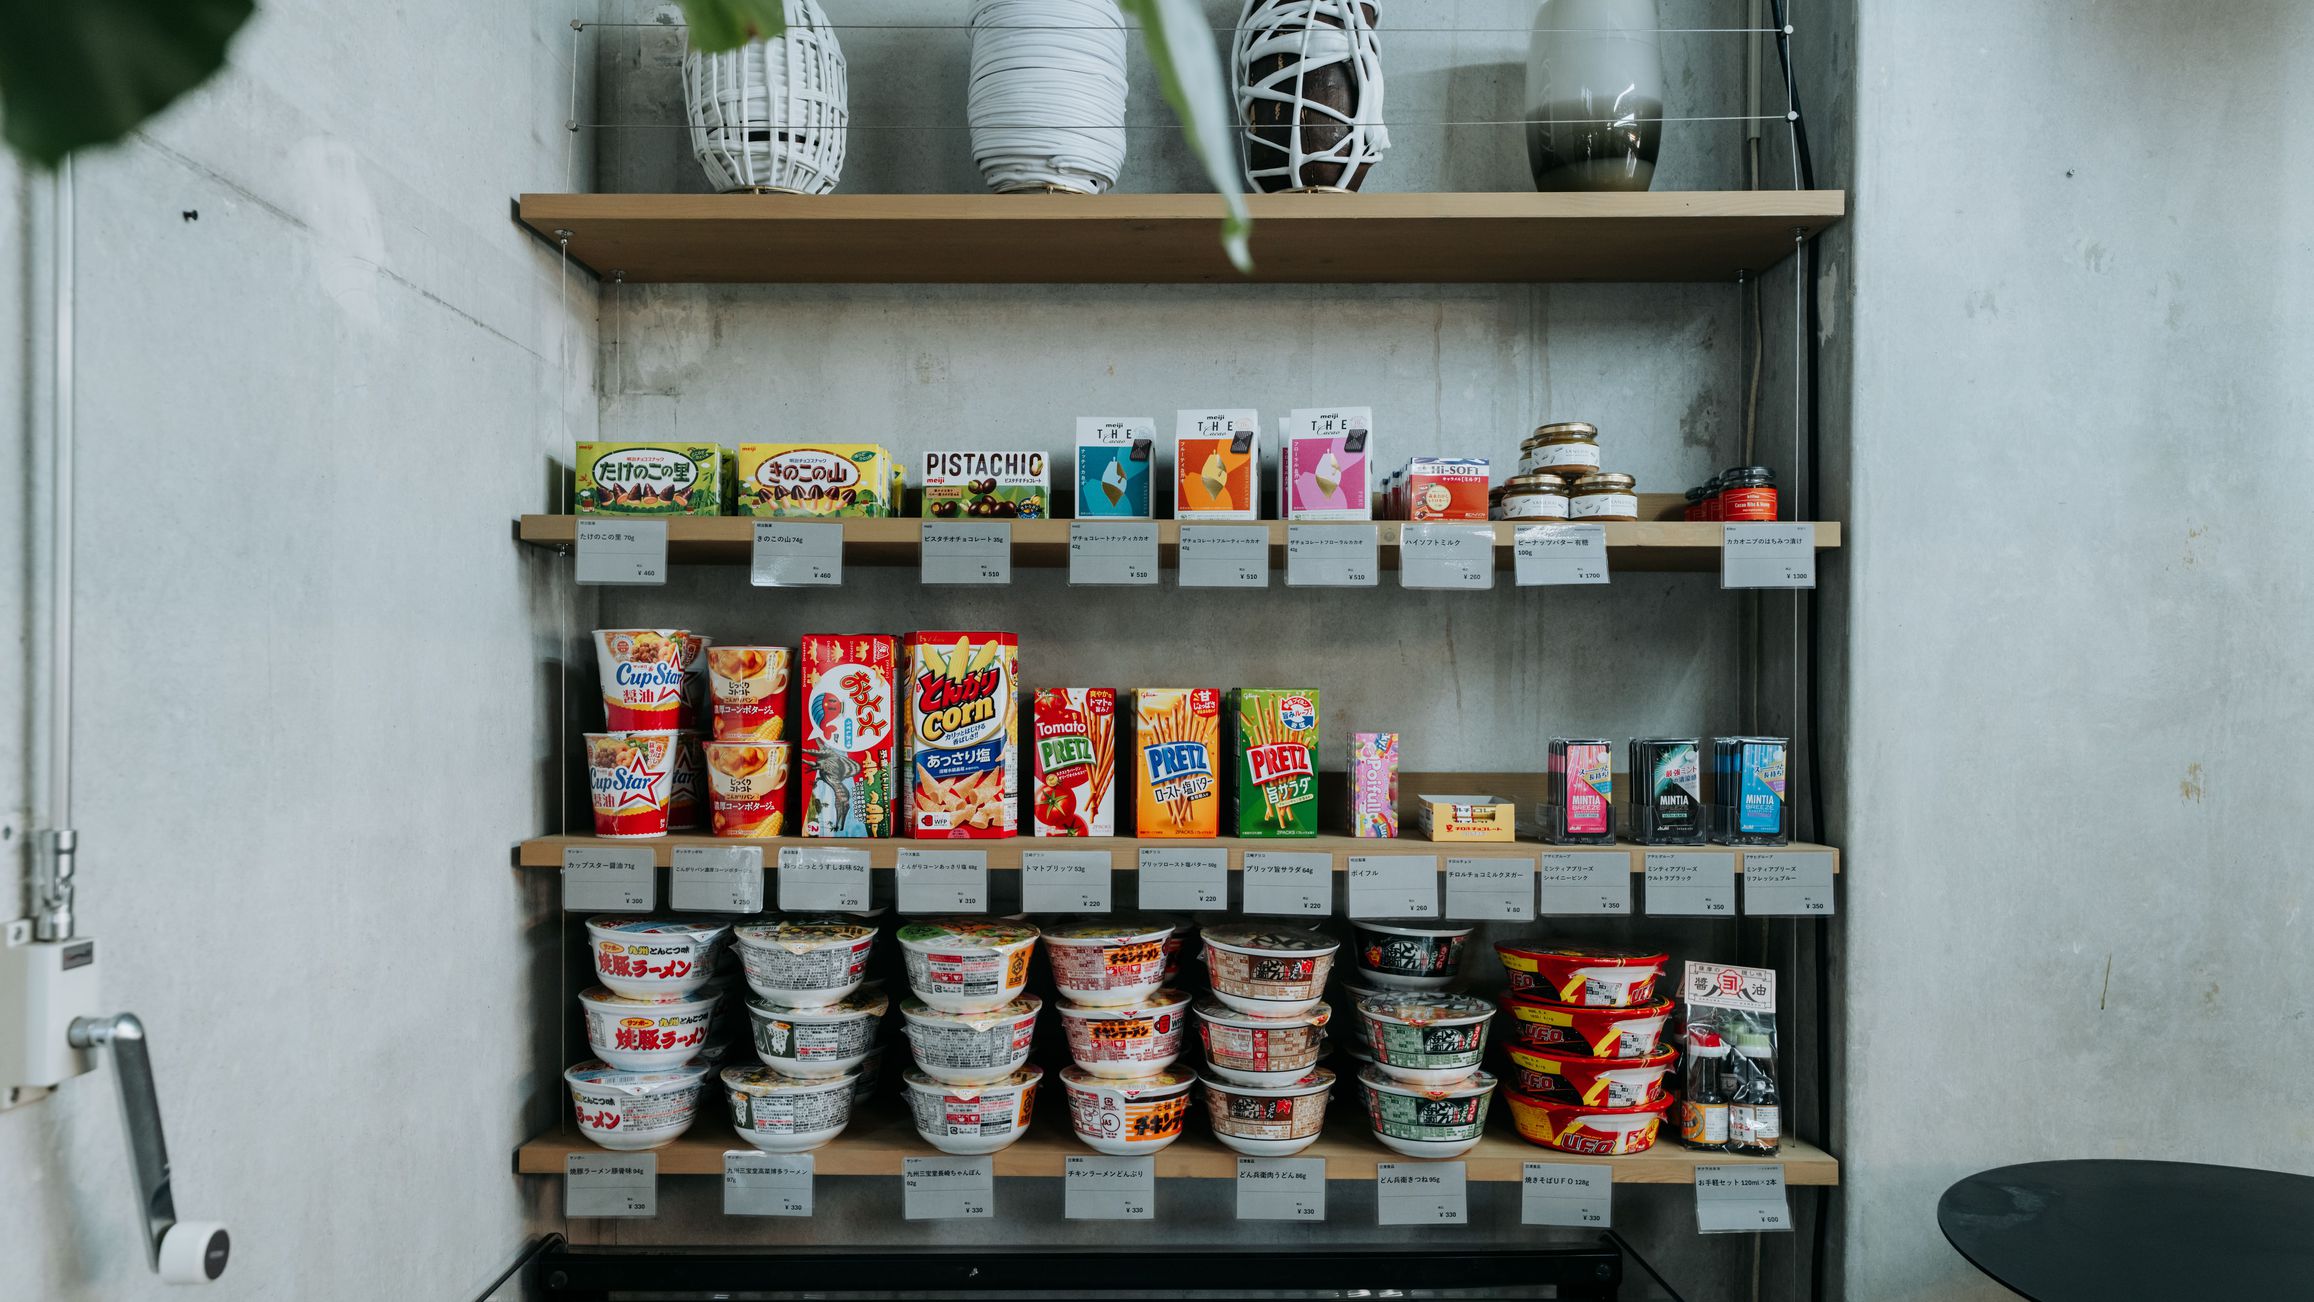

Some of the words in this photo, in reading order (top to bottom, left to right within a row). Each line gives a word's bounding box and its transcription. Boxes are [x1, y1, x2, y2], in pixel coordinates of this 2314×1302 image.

[1097, 429, 1132, 439] THE
[1197, 421, 1233, 431] THE
[1311, 419, 1347, 431] THE
[599, 461, 690, 482] たけのこの里
[769, 461, 847, 484] きのこの山
[927, 453, 1044, 477] PISTACHIO
[616, 662, 653, 688] Cup
[653, 662, 683, 685] Star
[623, 689, 654, 704] 醤油
[920, 667, 1000, 713] とんがり
[1199, 690, 1211, 702] 甘
[1090, 698, 1113, 707] トマトの
[922, 696, 996, 741] corn
[1036, 721, 1087, 736] Tomato
[945, 723, 986, 741] カリッとはじける
[927, 748, 991, 768] あっさり塩
[1041, 738, 1092, 768] PRETZ
[1149, 744, 1207, 779] PRETZ
[1251, 744, 1309, 779] PRETZ
[590, 767, 613, 792] Cup
[613, 767, 652, 790] Star
[1365, 758, 1382, 815] Poifull
[1267, 777, 1311, 804] 旨サラダ
[1572, 795, 1601, 805] MINTIA
[1660, 795, 1689, 805] MINTIA
[1745, 794, 1774, 805] MINTIA
[628, 945, 690, 956] 九州とんこつ味
[598, 950, 692, 979] 焼豚ラーメン
[1752, 983, 1767, 996] 油
[615, 1027, 708, 1051] 焼豚ラーメン
